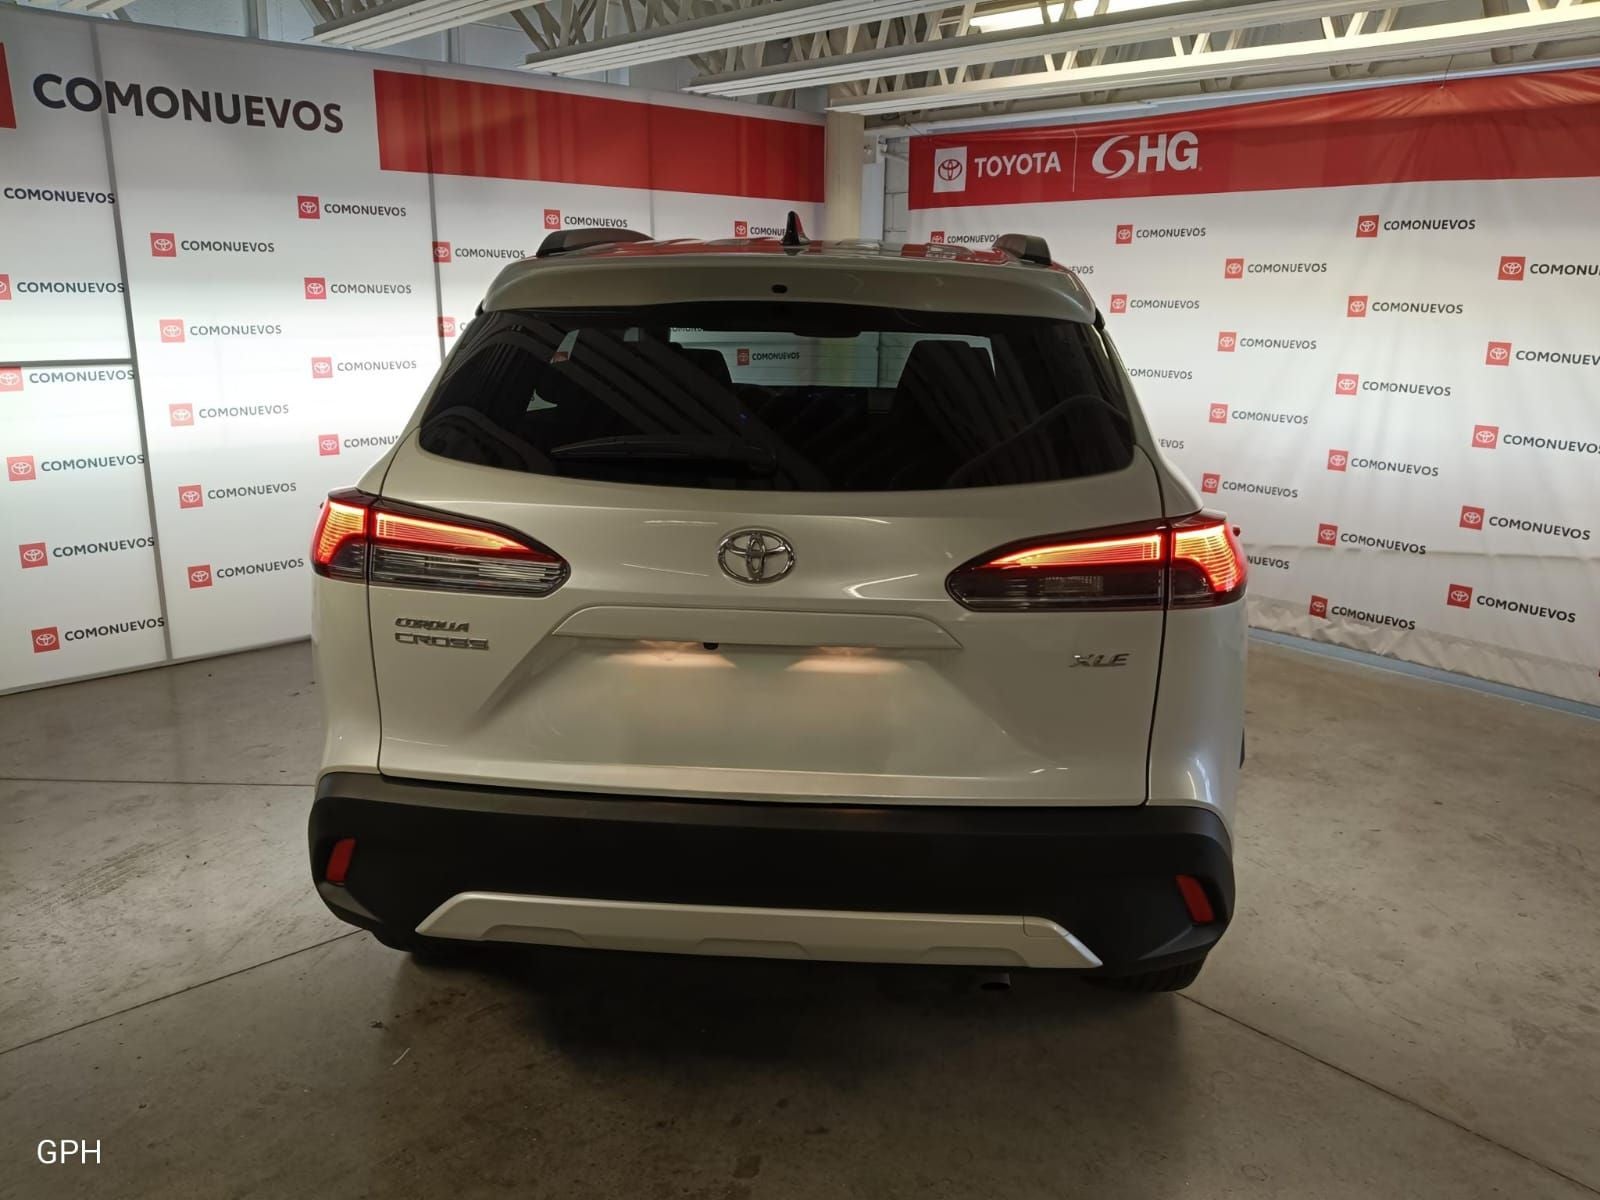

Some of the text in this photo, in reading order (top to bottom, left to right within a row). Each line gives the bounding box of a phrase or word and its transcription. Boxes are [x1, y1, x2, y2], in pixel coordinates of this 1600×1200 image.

[33, 73, 343, 133] COMONUEVOS
[975, 151, 1061, 177] TOYOTA
[4, 188, 115, 204] COMONUEVOS
[324, 203, 407, 217] COMONUEVOS
[564, 215, 628, 228] COMONUEVOS
[1383, 219, 1476, 231] COMONUEVOS
[1136, 227, 1206, 238] COMONUEVOS
[181, 240, 275, 253] COMONUEVOS
[455, 247, 526, 259] COMONUEVOS
[1248, 262, 1327, 273] COMONUEVOS
[1530, 263, 1600, 276] COMONU
[17, 281, 125, 293] COMONUEVOS
[330, 283, 412, 294] COMONUEVOS
[1130, 299, 1200, 309] COMONUEVOS
[1372, 302, 1463, 314] COMONUEVOS
[190, 324, 282, 336] COMONUEVOS
[1240, 338, 1317, 350] COMONUEVOS
[752, 351, 800, 361] COMONUEVOS
[337, 360, 417, 372] COMONUEVOS
[29, 369, 134, 384] COMONUEVOS
[1127, 368, 1193, 380] OMONUEVOS
[1362, 381, 1451, 397] COMONUEVOS
[199, 405, 289, 418] COMONUEVOS
[1232, 410, 1309, 425] COMONUEVOS
[41, 454, 144, 472] COMONUEVOS
[1351, 458, 1439, 477] COMONUEVOS
[207, 483, 297, 500] COMONUEVOS
[1222, 481, 1298, 498] COMONUEVOS
[1489, 516, 1591, 540] COMONUEVOS
[53, 537, 155, 558] COMONUEVOS
[1341, 533, 1426, 555] COMONUEVOS
[217, 558, 304, 579] COMONUEVOS
[1477, 595, 1576, 623] COMONUEVOS
[395, 618, 470, 632] COROLLA
[1331, 606, 1415, 630] COMONUEVOS
[65, 618, 165, 641] COMONUEVOS
[395, 632, 489, 650] CROSS
[1069, 653, 1130, 668] XLE
